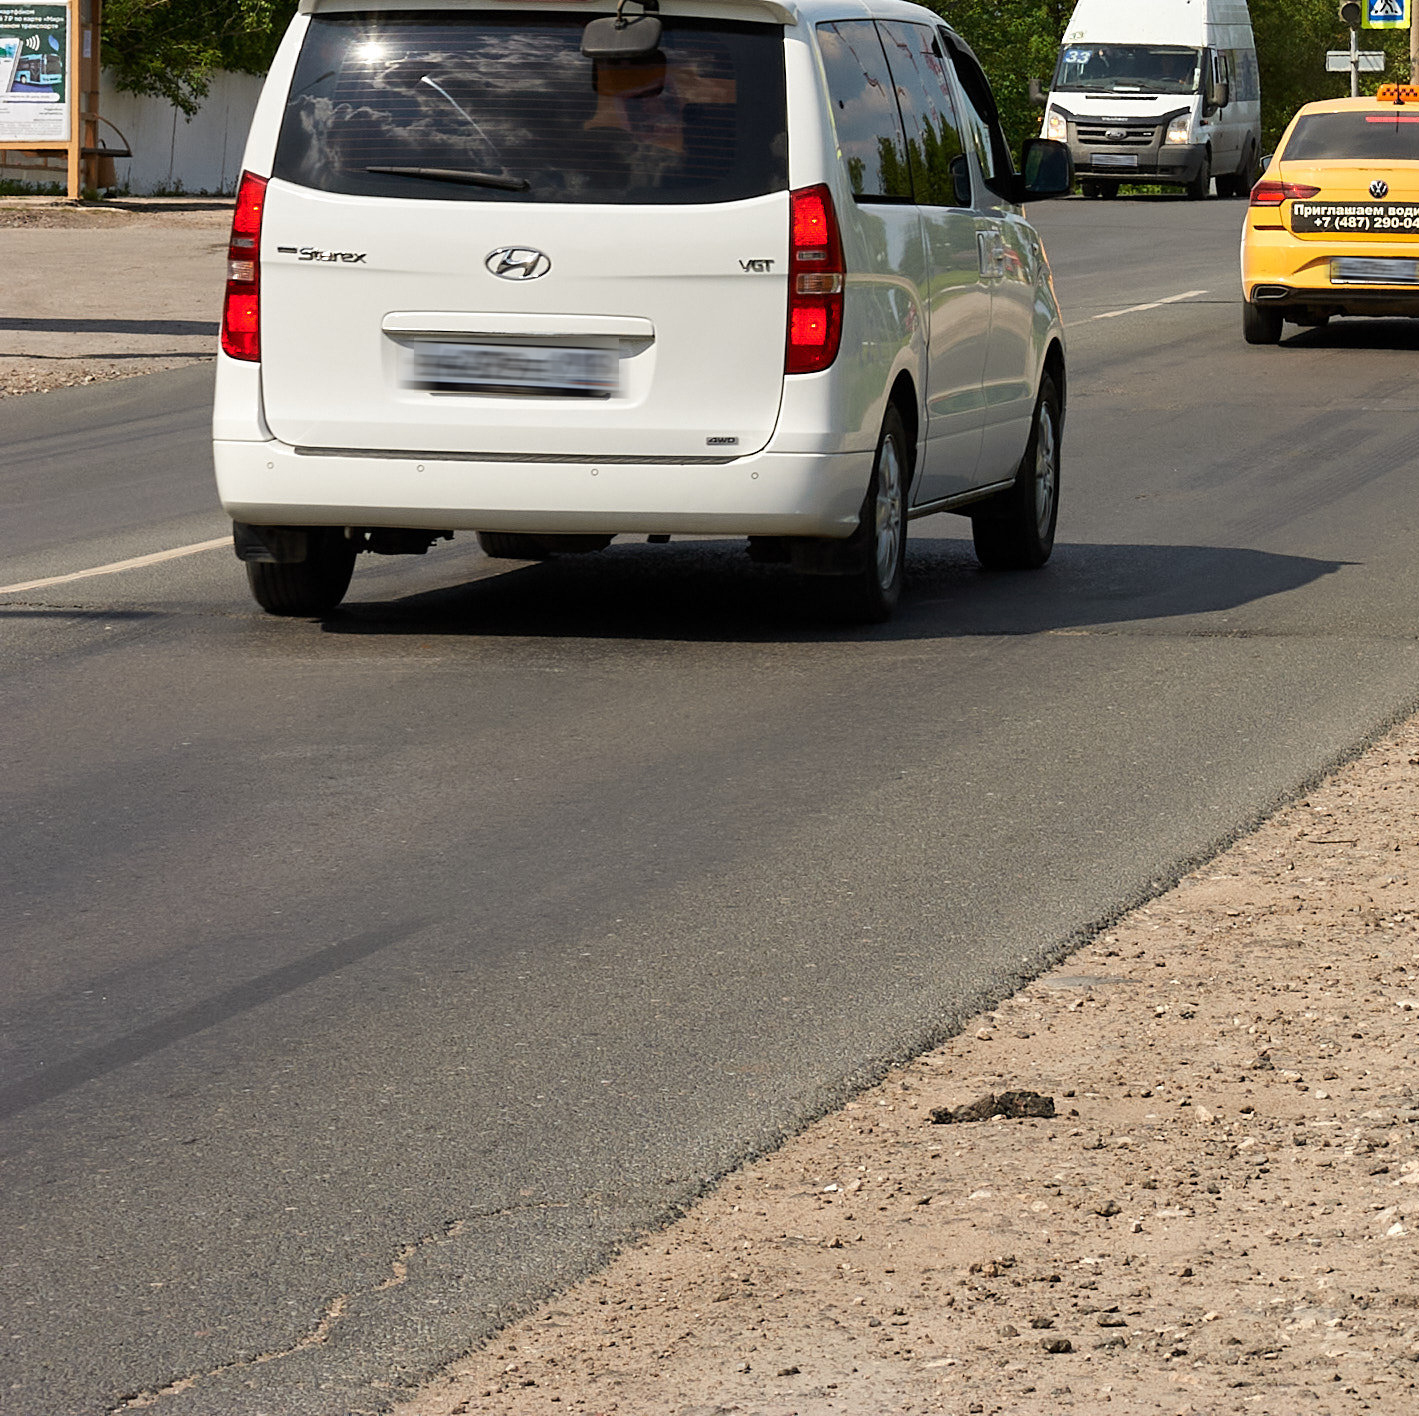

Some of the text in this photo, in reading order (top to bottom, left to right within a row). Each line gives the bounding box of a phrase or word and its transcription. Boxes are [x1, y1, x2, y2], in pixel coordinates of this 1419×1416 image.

[1065, 50, 1091, 63] 33
[1293, 203, 1384, 218] Приглашаем
[1314, 216, 1330, 228] +7
[1334, 216, 1370, 230] (487)
[298, 247, 367, 264] Starex
[739, 259, 774, 272] VGT
